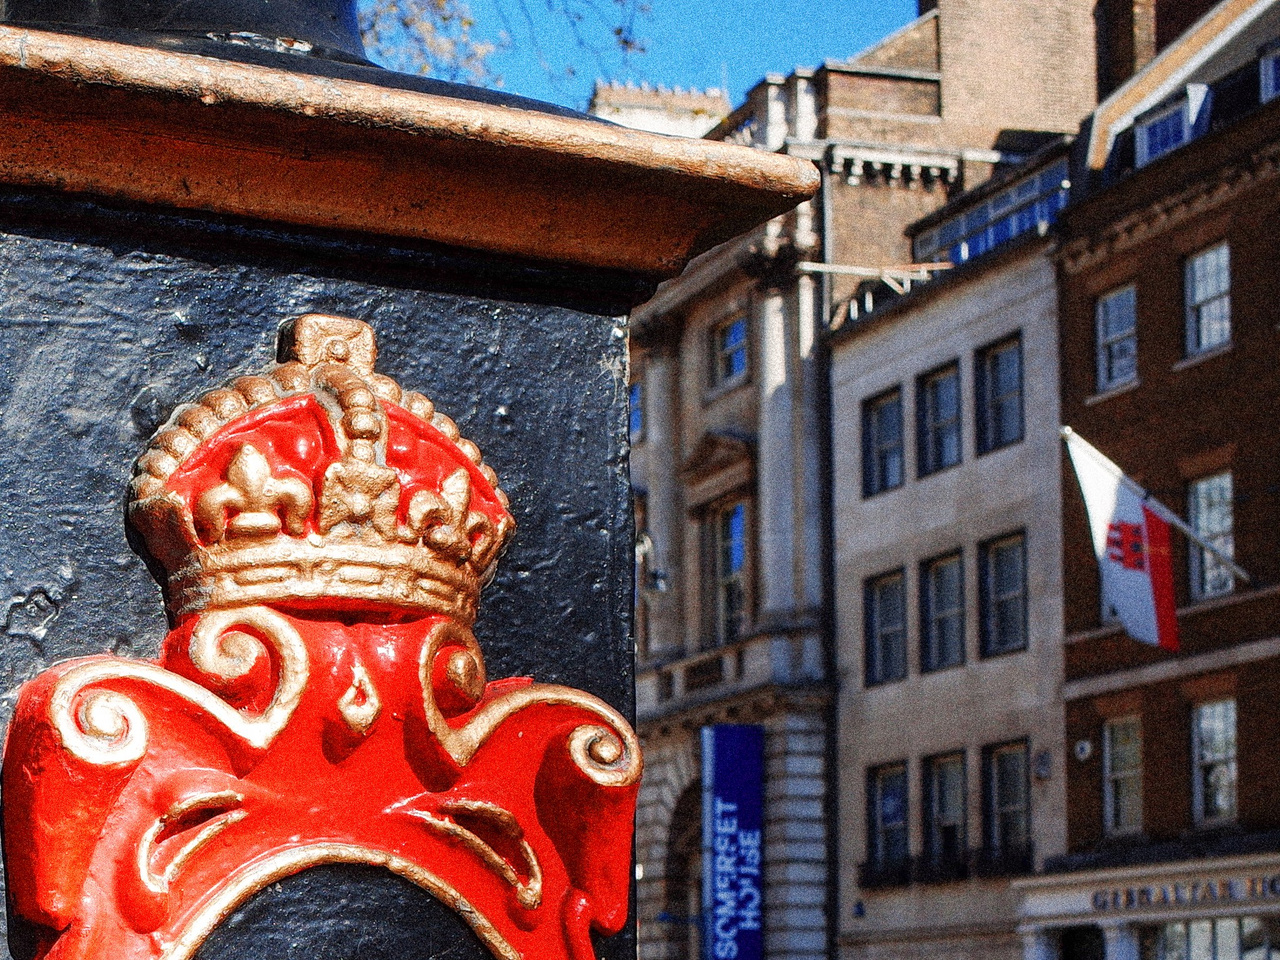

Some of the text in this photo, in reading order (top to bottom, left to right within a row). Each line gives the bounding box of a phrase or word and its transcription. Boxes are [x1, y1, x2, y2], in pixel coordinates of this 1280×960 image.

[714, 797, 739, 959] SOMERSET
[738, 829, 761, 930] HOUSE
[1092, 877, 1233, 911] GIBRALTAR
